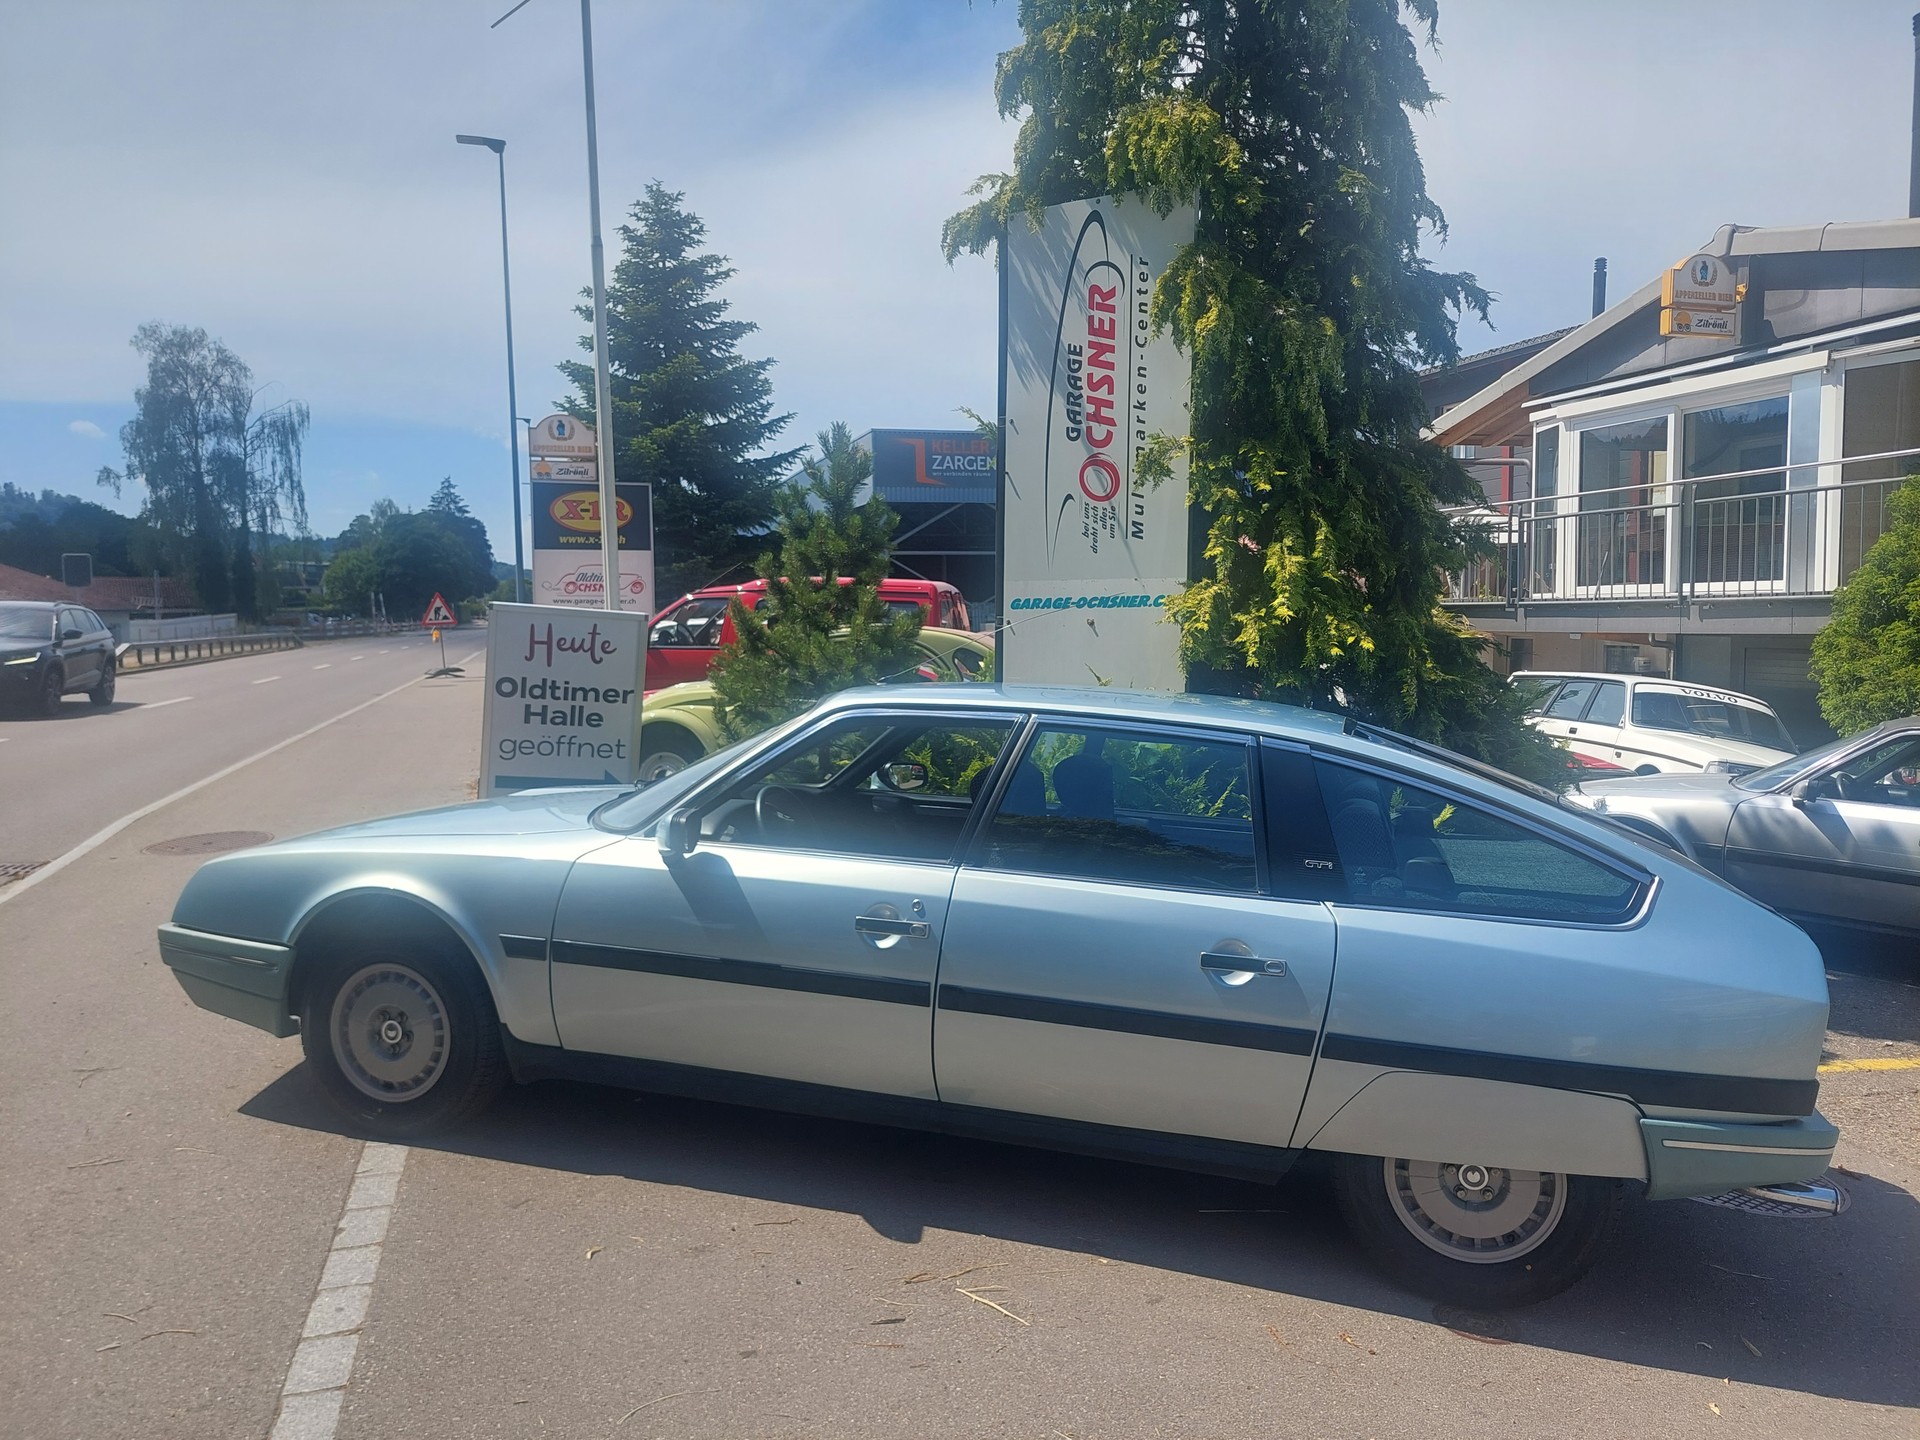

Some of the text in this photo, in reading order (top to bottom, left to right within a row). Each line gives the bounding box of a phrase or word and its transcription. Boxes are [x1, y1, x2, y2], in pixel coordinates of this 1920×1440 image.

[1695, 319, 1728, 329] Zitrönli
[1065, 343, 1083, 442] GARAGE
[1079, 283, 1120, 502] OCHSNER
[1131, 256, 1149, 540] Mulmarken-Center
[932, 440, 989, 454] KELLER
[556, 467, 589, 476] Zitrönli
[932, 455, 997, 471] ZARGEN
[1081, 520, 1090, 539] bei
[1090, 505, 1099, 554] dreht sich
[1099, 506, 1108, 530] alles
[1108, 505, 1116, 539] um Sie
[1010, 594, 1168, 610] GARAGE-OCHSNER.C
[524, 623, 617, 668] Heute
[495, 676, 635, 704] Oldtimer
[1680, 688, 1738, 704] VOLVO
[523, 704, 604, 728] Halle
[499, 735, 626, 761] geöffnet
